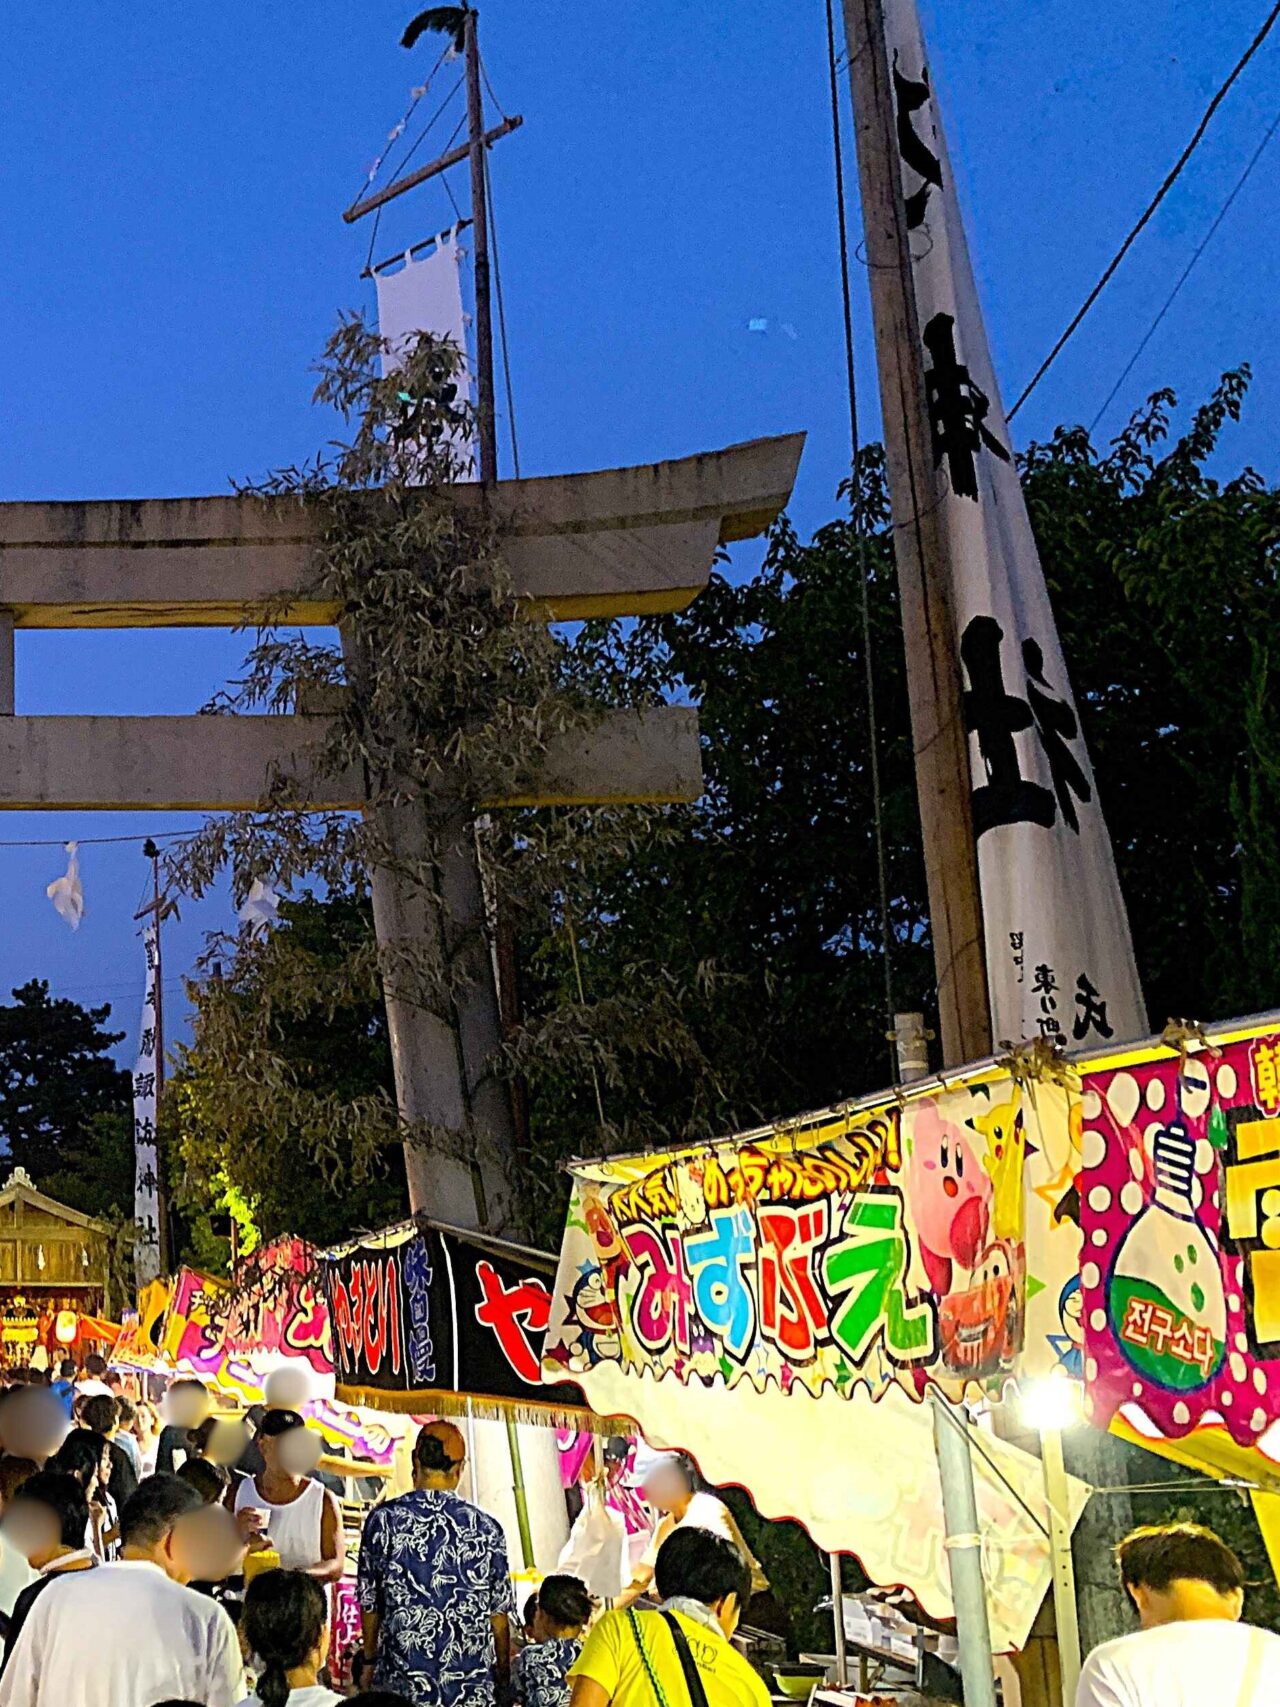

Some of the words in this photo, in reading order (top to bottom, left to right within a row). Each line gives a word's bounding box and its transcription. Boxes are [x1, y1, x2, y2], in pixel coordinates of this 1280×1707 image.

[624, 1198, 934, 1368] みずぶえ
[1121, 1296, 1216, 1382] 전구소다
